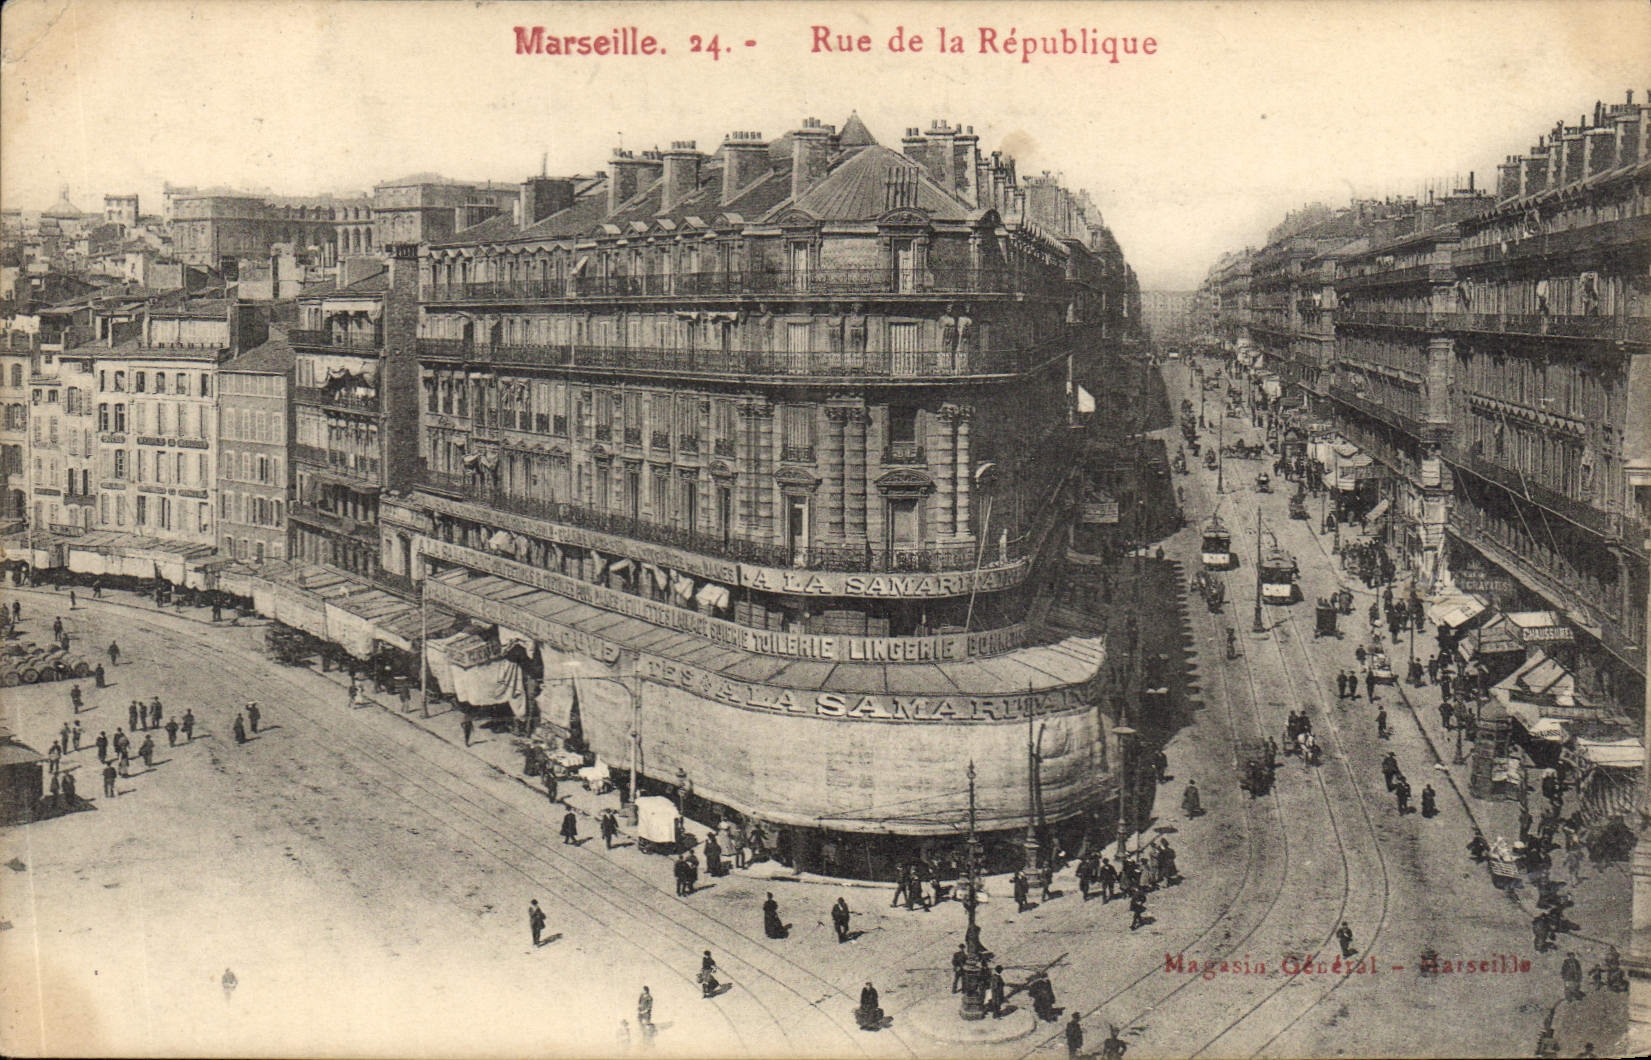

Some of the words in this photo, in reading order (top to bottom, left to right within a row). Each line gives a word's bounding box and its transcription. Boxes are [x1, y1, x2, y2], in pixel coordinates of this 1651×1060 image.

[753, 567, 777, 589] A
[783, 570, 834, 596] LA
[849, 637, 955, 662] LINGERIE
[746, 685, 806, 713] LA
